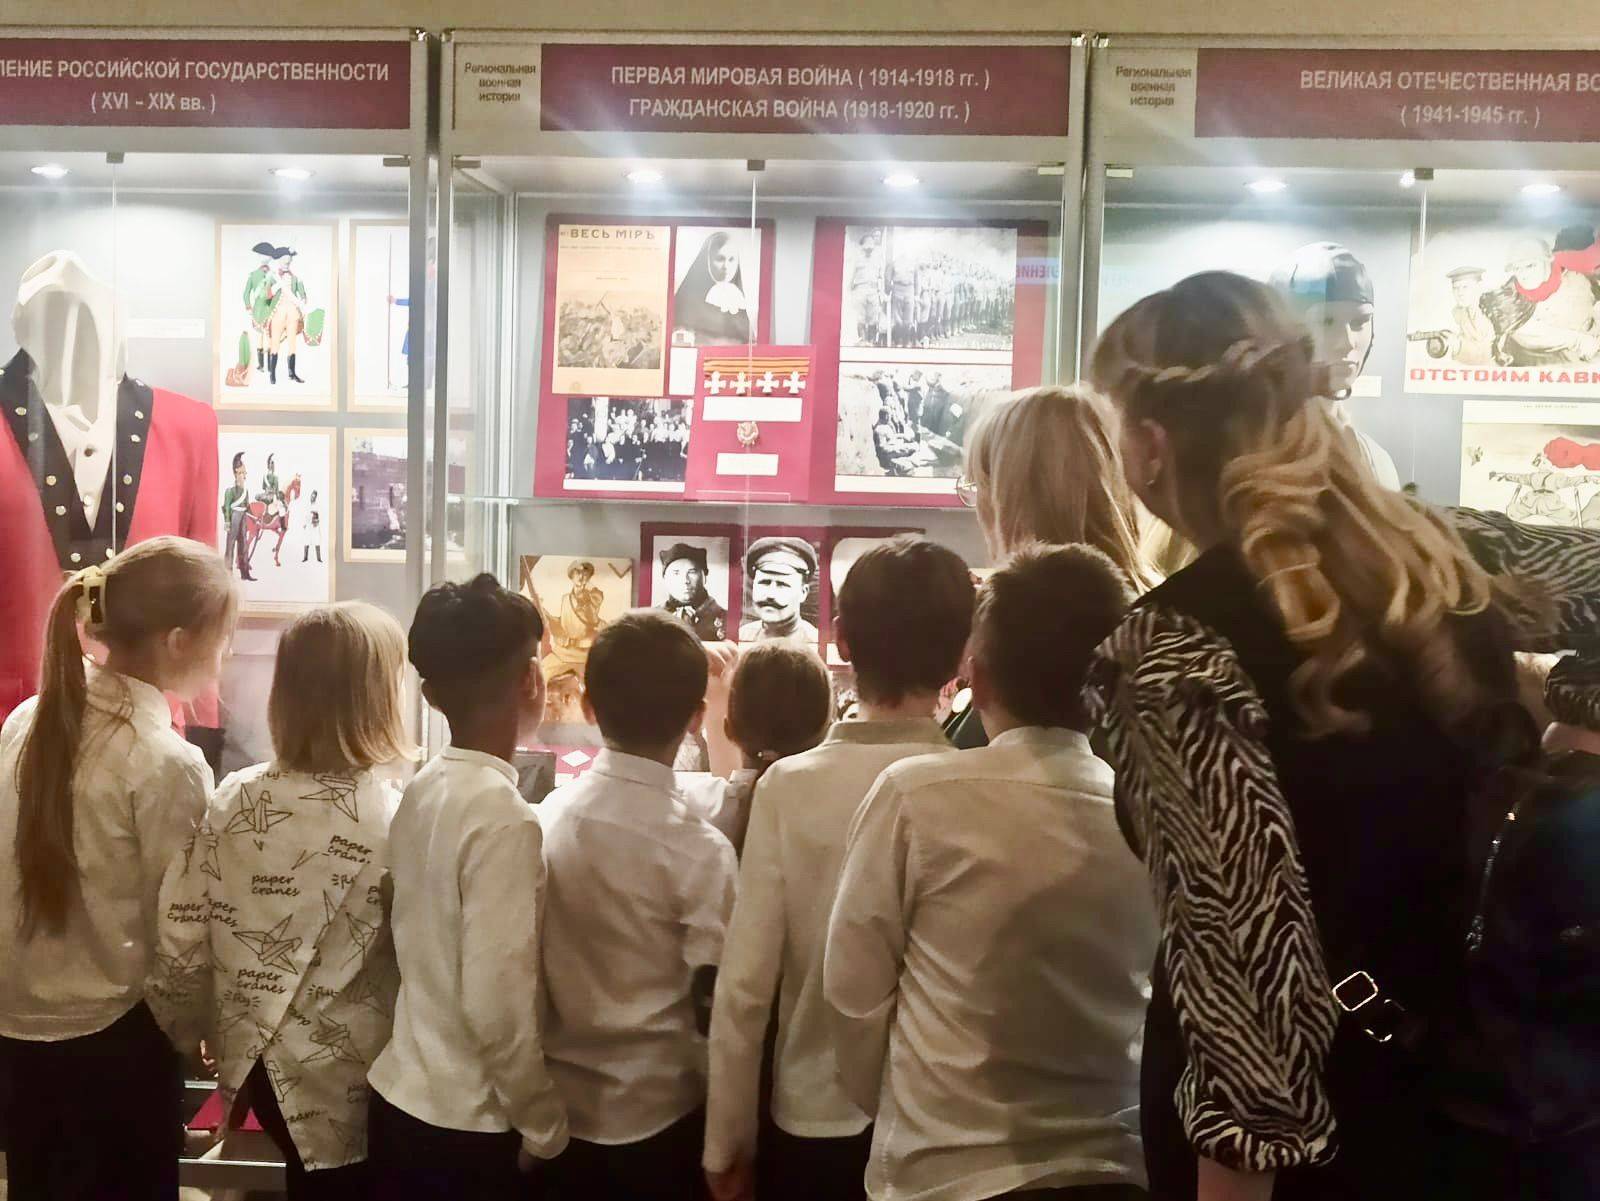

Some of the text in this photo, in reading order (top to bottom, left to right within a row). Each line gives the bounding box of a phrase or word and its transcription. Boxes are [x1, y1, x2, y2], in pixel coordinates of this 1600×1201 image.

[57, 58, 180, 79] РОССИЙСКОЙ
[184, 61, 389, 83] ГОСУДАРСТВЕННОСТИ
[611, 66, 686, 85] ПЕРВАЯ
[691, 67, 782, 86] МИРОВАЯ
[788, 65, 853, 87] ВОЙНА
[869, 68, 955, 87] 1914-1918
[1300, 70, 1392, 89] ВЕЛИКАЯ
[1397, 71, 1571, 92] ОТЕЧЕСТВЕННАЯ
[629, 99, 768, 120] ГРАЖДАНСКАЯ
[773, 97, 838, 119] ВОЙНА
[1413, 104, 1503, 123] 1941-1945
[570, 228, 610, 239] ВЕСЬ
[1410, 368, 1530, 382] ОТСТОИМ
[330, 834, 373, 855] paper
[251, 874, 295, 886] paper
[251, 886, 301, 897] cranes
[237, 968, 282, 982] paper
[237, 981, 287, 995] cranes
